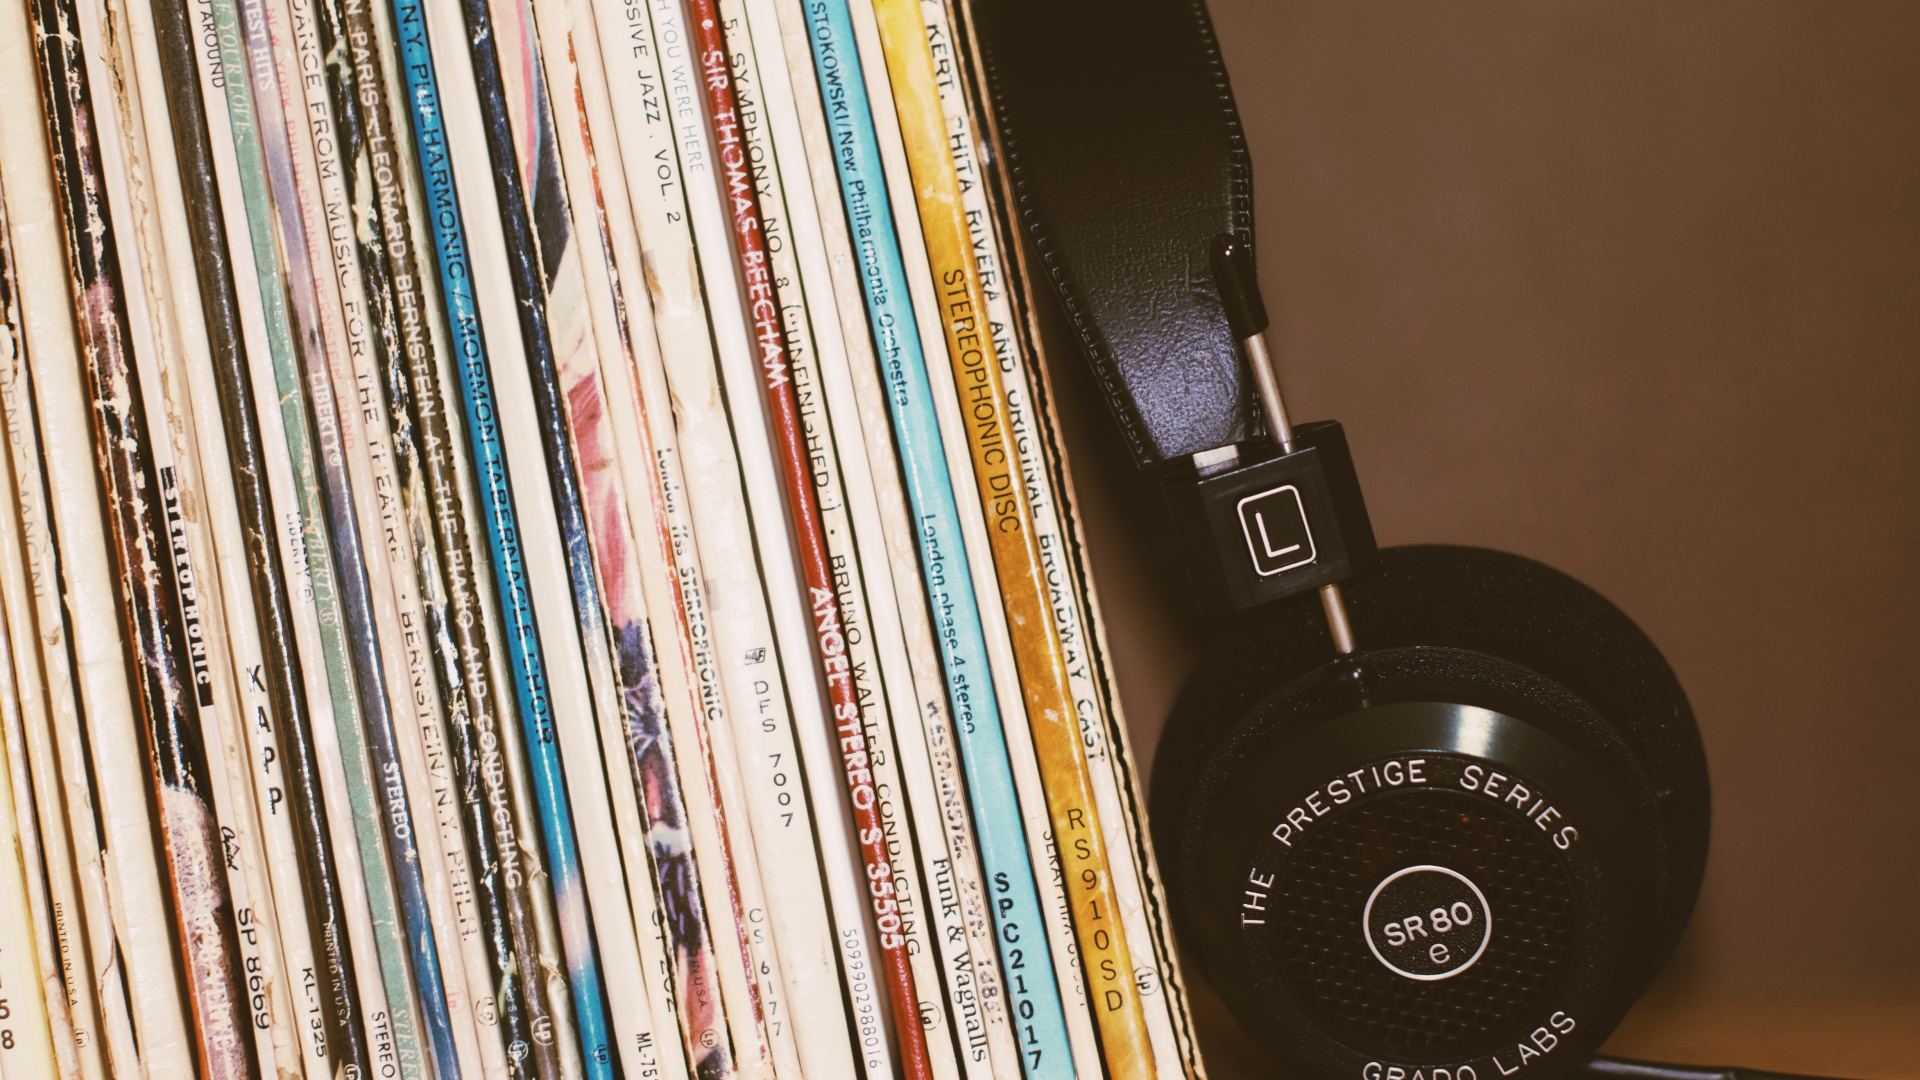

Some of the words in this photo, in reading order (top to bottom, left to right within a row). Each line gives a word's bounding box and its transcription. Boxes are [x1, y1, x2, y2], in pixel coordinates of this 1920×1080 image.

[198, 10, 224, 89] AROUND
[217, 22, 243, 76] YOUR
[399, 4, 424, 52] N.Y.
[660, 18, 681, 59] YOU
[253, 46, 276, 92] HITS
[670, 66, 693, 117] WERE
[701, 49, 729, 92] SIR
[410, 62, 466, 280] PHILHARMONIC
[636, 68, 661, 124] JAZZ
[653, 149, 676, 202] VOL.
[665, 209, 681, 224] 2
[682, 125, 704, 174] HERE
[713, 107, 758, 234] THOMAS
[309, 101, 338, 179] FROM
[344, 300, 368, 357] FOR
[356, 370, 380, 424] THE
[848, 179, 890, 305] Philharmonia
[877, 312, 912, 407] Orchestra
[394, 274, 436, 418] BERNSTEIN
[741, 249, 789, 389] BEECHAM
[458, 315, 497, 444] MORMON
[942, 268, 1006, 466] STEREOPHONIC
[988, 473, 1021, 534] DISC
[423, 432, 445, 467] AT
[946, 116, 979, 194] HITA
[966, 208, 1002, 301] RIVERA
[991, 319, 1019, 374] AND
[1006, 387, 1051, 519] ORIGINAL
[1039, 532, 1087, 682] BROADWAY
[1075, 697, 1106, 764] CAST
[432, 480, 458, 535] THE
[729, 52, 772, 200] SYMPHONY
[773, 276, 790, 289] 8
[830, 554, 862, 646] BRUNO
[851, 661, 885, 768] WALTER
[875, 782, 921, 957] CONDUCTING
[1255, 512, 1300, 557] L
[163, 487, 210, 685] STEREOPHONIC
[484, 454, 534, 641] TABERNACLE
[656, 447, 683, 514] London
[679, 565, 723, 721] STEREOPHONIC
[919, 514, 948, 586] London
[445, 548, 475, 629] PIANO
[932, 591, 962, 655] phase
[462, 642, 488, 699] AND
[809, 583, 851, 686] ANGEL
[948, 655, 965, 669] 4
[521, 652, 553, 746] CHOIR
[952, 672, 979, 735] stereo
[244, 665, 286, 814] KAPP
[753, 680, 776, 733] DFS
[768, 753, 795, 827] 7007
[833, 700, 876, 811] STEREO
[381, 760, 411, 839] STEREO
[475, 713, 522, 889] CONDUCTING
[858, 825, 883, 846] S
[1241, 867, 1275, 929] THE
[1272, 759, 1427, 846] PRESTIGE
[1459, 765, 1579, 850] SERIES
[236, 906, 256, 946] SP
[865, 860, 905, 950] 35505
[931, 856, 960, 919] Funk
[52, 902, 70, 953] PRINTED
[62, 958, 73, 971] IN
[945, 923, 964, 944] &
[991, 871, 1045, 1071] SPC21017
[1429, 943, 1450, 964] e
[244, 955, 271, 1030] 8669
[300, 967, 328, 1057] KL-1325
[330, 978, 342, 991] IN
[758, 959, 784, 1037] 6177
[842, 928, 882, 1069] 5099902988016
[945, 951, 989, 1064] Wagnalls
[370, 1011, 396, 1079] STEREO
[391, 1005, 420, 1080] STERE
[635, 1031, 658, 1080] ML-75
[1492, 1011, 1576, 1076] LABS
